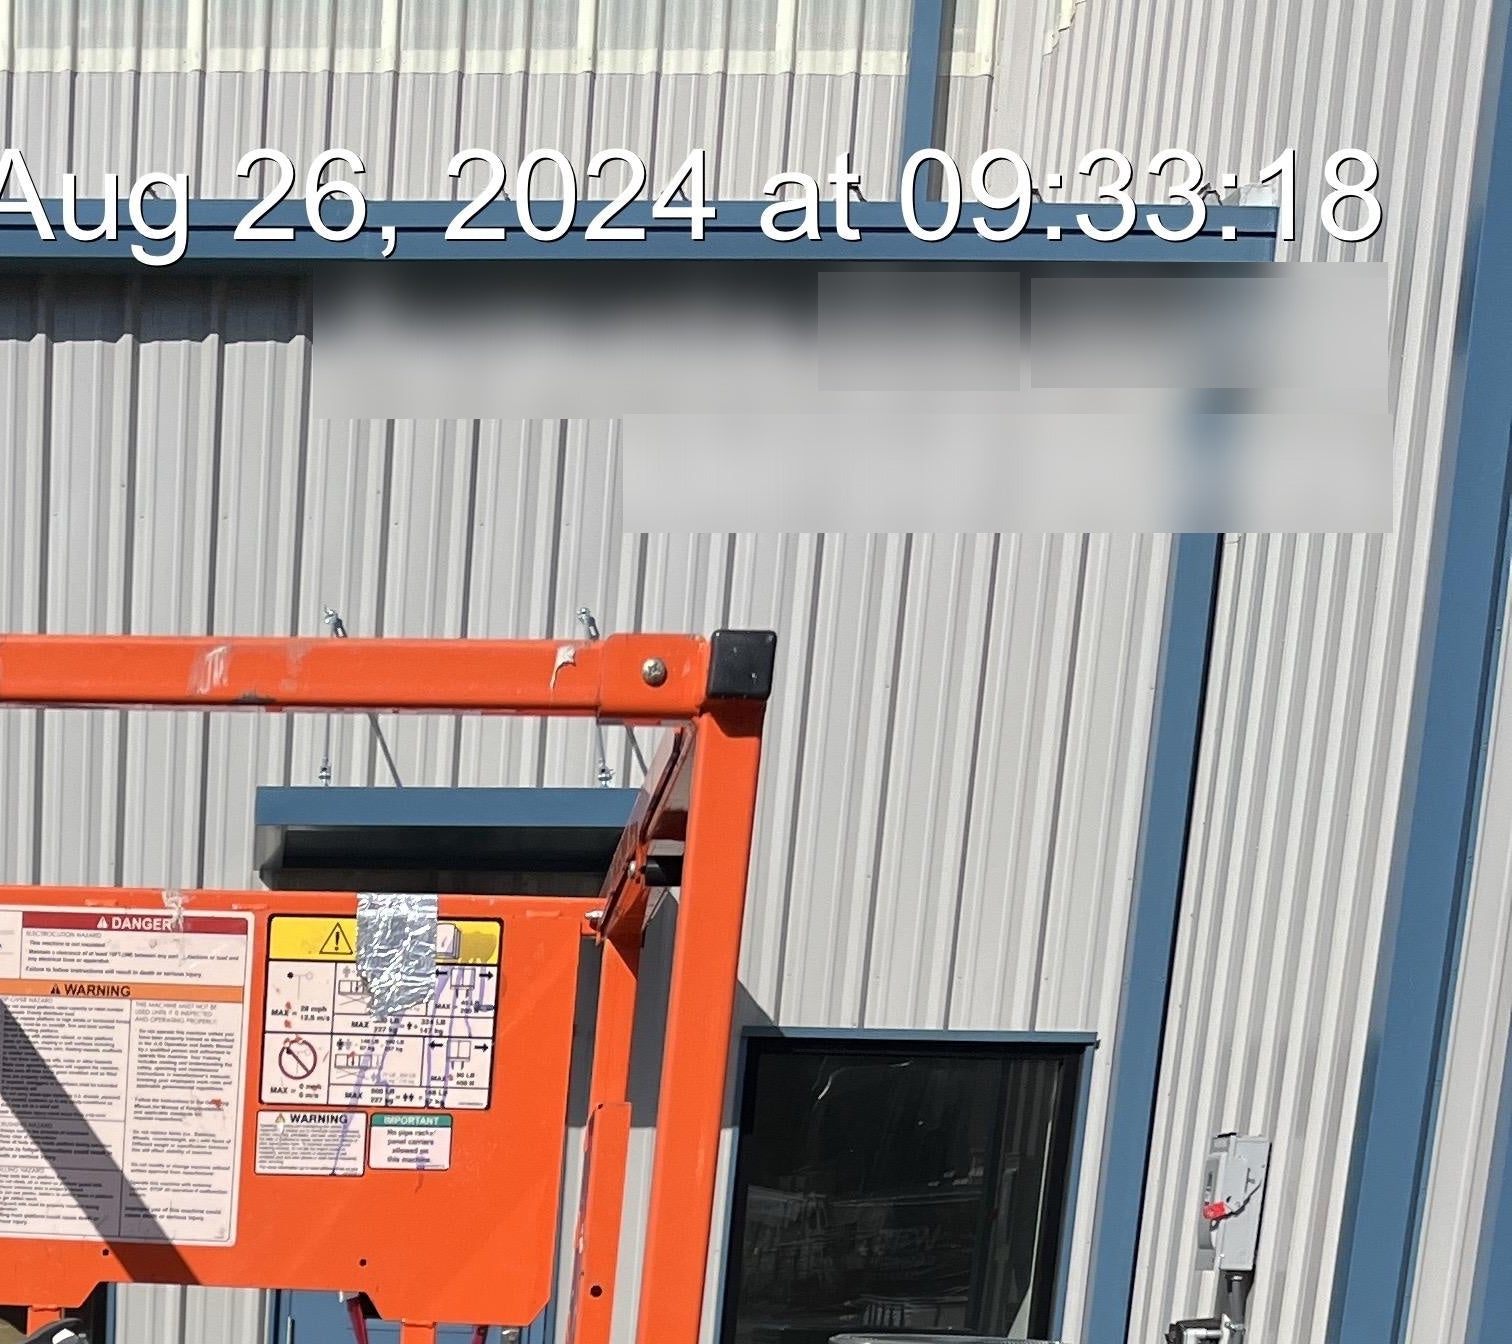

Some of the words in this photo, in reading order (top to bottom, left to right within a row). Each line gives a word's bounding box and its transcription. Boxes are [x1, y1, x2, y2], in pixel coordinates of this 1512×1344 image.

[110, 917, 173, 931] DANGER
[63, 983, 131, 997] WARNING
[289, 1113, 348, 1123] WARNING
[383, 1115, 440, 1125] IMPORTANT
